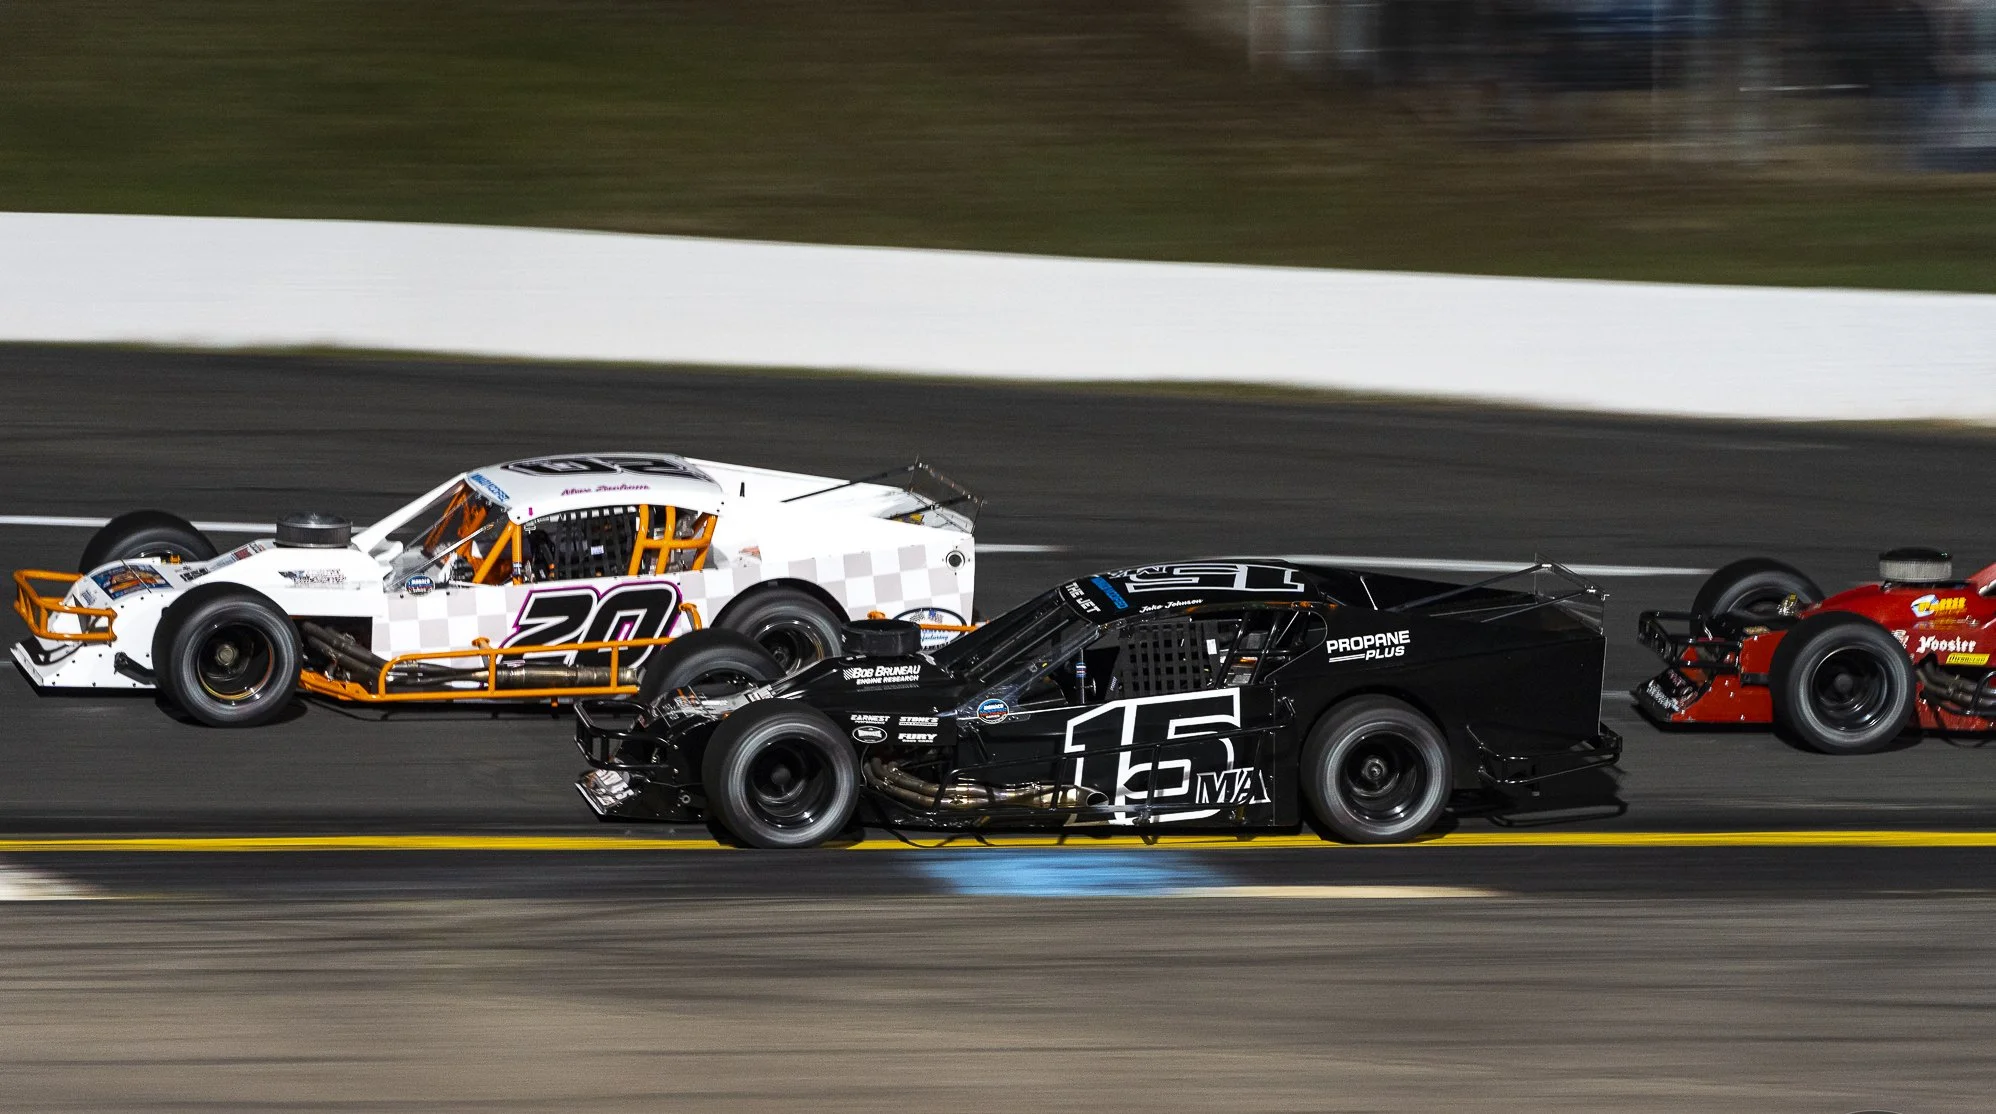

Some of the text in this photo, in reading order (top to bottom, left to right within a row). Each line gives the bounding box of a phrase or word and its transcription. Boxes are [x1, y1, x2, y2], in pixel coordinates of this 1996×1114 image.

[1065, 582, 1101, 613] THE JET
[1164, 599, 1203, 609] Johnson
[496, 581, 683, 669] 20
[1326, 630, 1411, 654] PROPANE
[1365, 645, 1405, 660] PLUS
[883, 675, 920, 683] RESEARCH
[850, 714, 891, 722] EARNEST
[1064, 687, 1241, 826] 15
